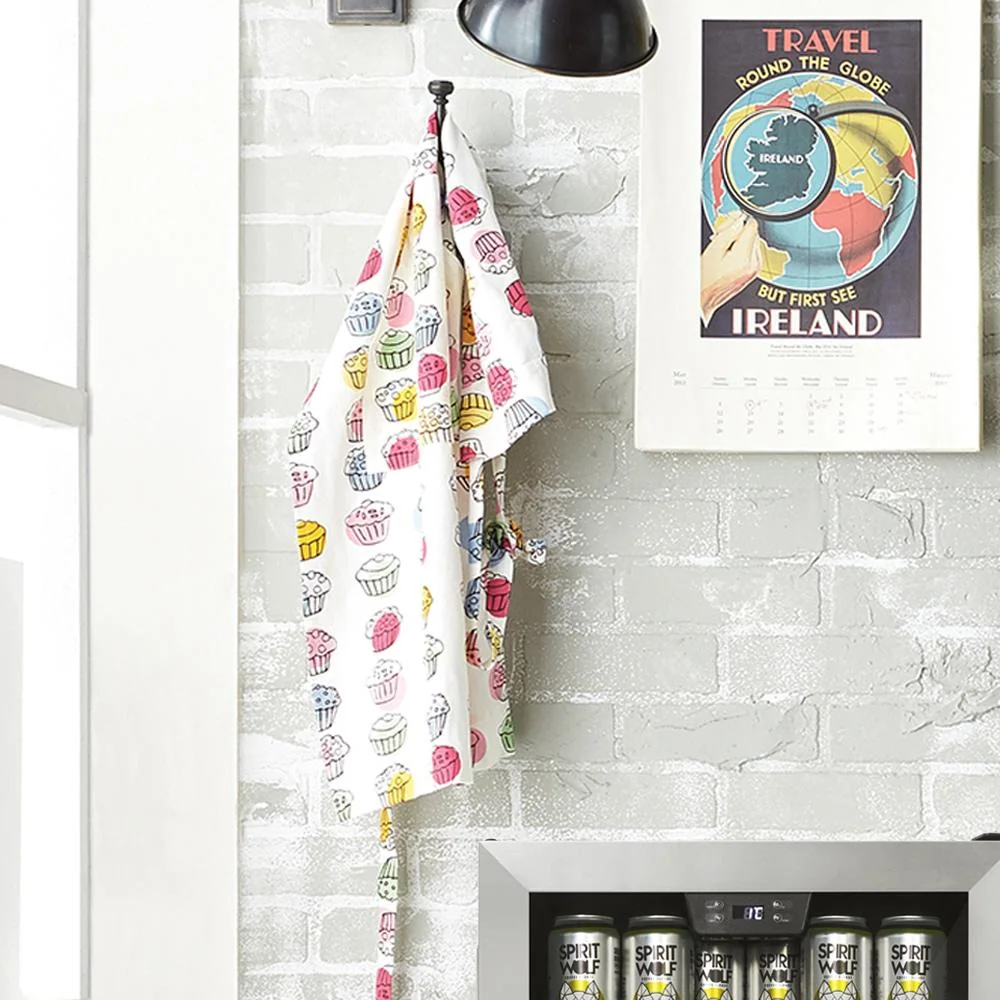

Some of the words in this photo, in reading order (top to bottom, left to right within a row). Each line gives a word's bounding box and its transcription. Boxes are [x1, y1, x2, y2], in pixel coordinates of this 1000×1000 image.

[762, 28, 877, 53] TRAVEL
[736, 58, 792, 91] ROUND
[799, 56, 830, 71] THE
[839, 61, 892, 97] GLOBE
[759, 153, 805, 165] IRELAND
[757, 284, 788, 305] BUT
[789, 292, 827, 308] FIRST
[830, 285, 858, 305] SEE
[732, 308, 883, 337] IRELAND
[559, 943, 600, 960] SPIRIT
[635, 945, 677, 961] SPIRIT
[818, 944, 858, 960] SPIRIT
[891, 945, 931, 960] SPIRIT
[560, 960, 600, 975] WOLF
[636, 961, 677, 977] WOLF
[818, 960, 858, 975] WOLF
[891, 960, 931, 975] WOLF
